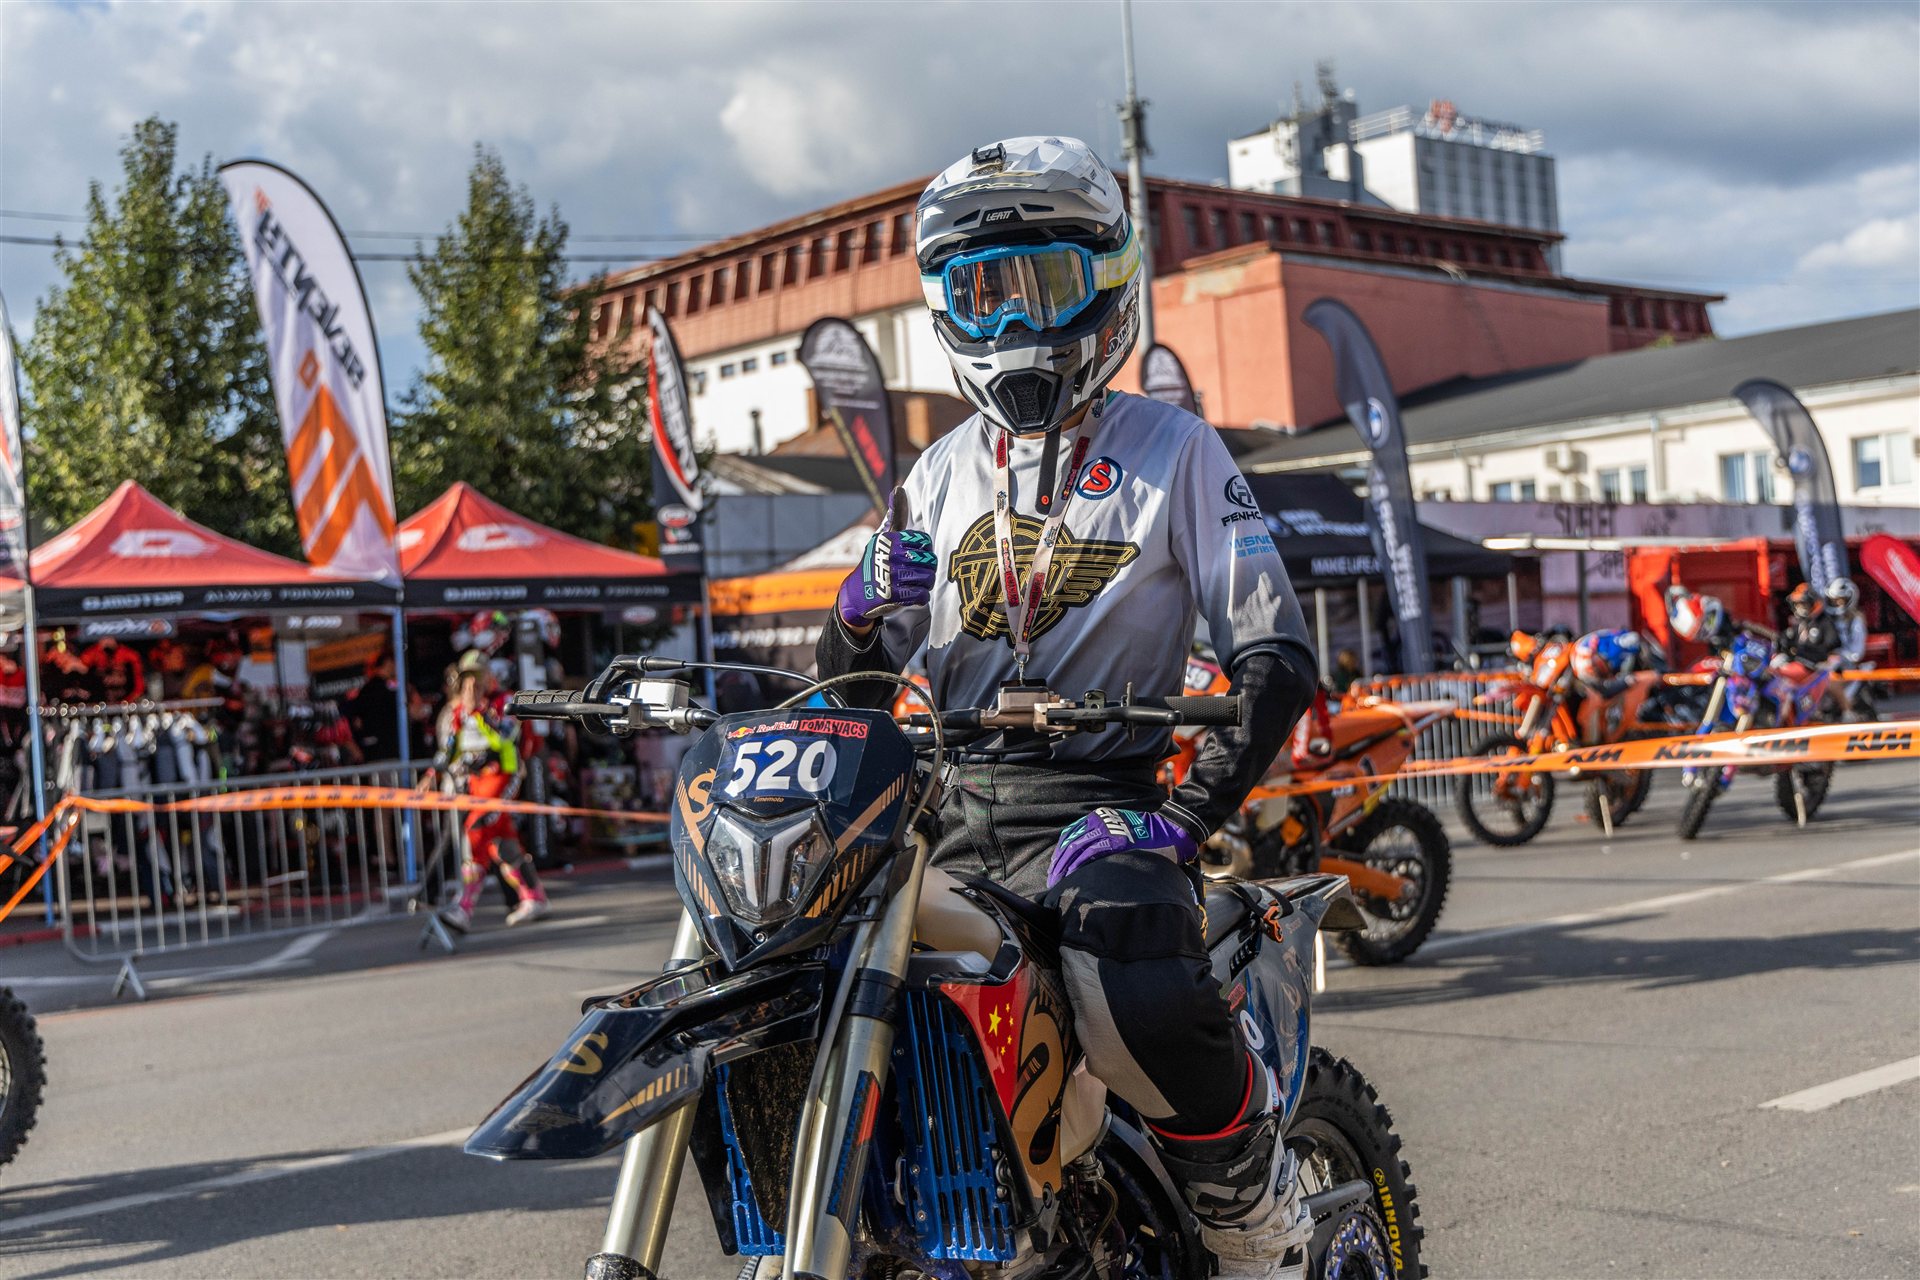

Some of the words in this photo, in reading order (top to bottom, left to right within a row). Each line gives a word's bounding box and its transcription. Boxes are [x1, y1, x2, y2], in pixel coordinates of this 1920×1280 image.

[985, 210, 1014, 222] LEATT
[724, 739, 838, 798] 520
[1565, 748, 1623, 764] KTM
[1653, 740, 1712, 759] KTM
[1846, 728, 1912, 752] KTM
[1378, 1185, 1404, 1271] INNOVA
